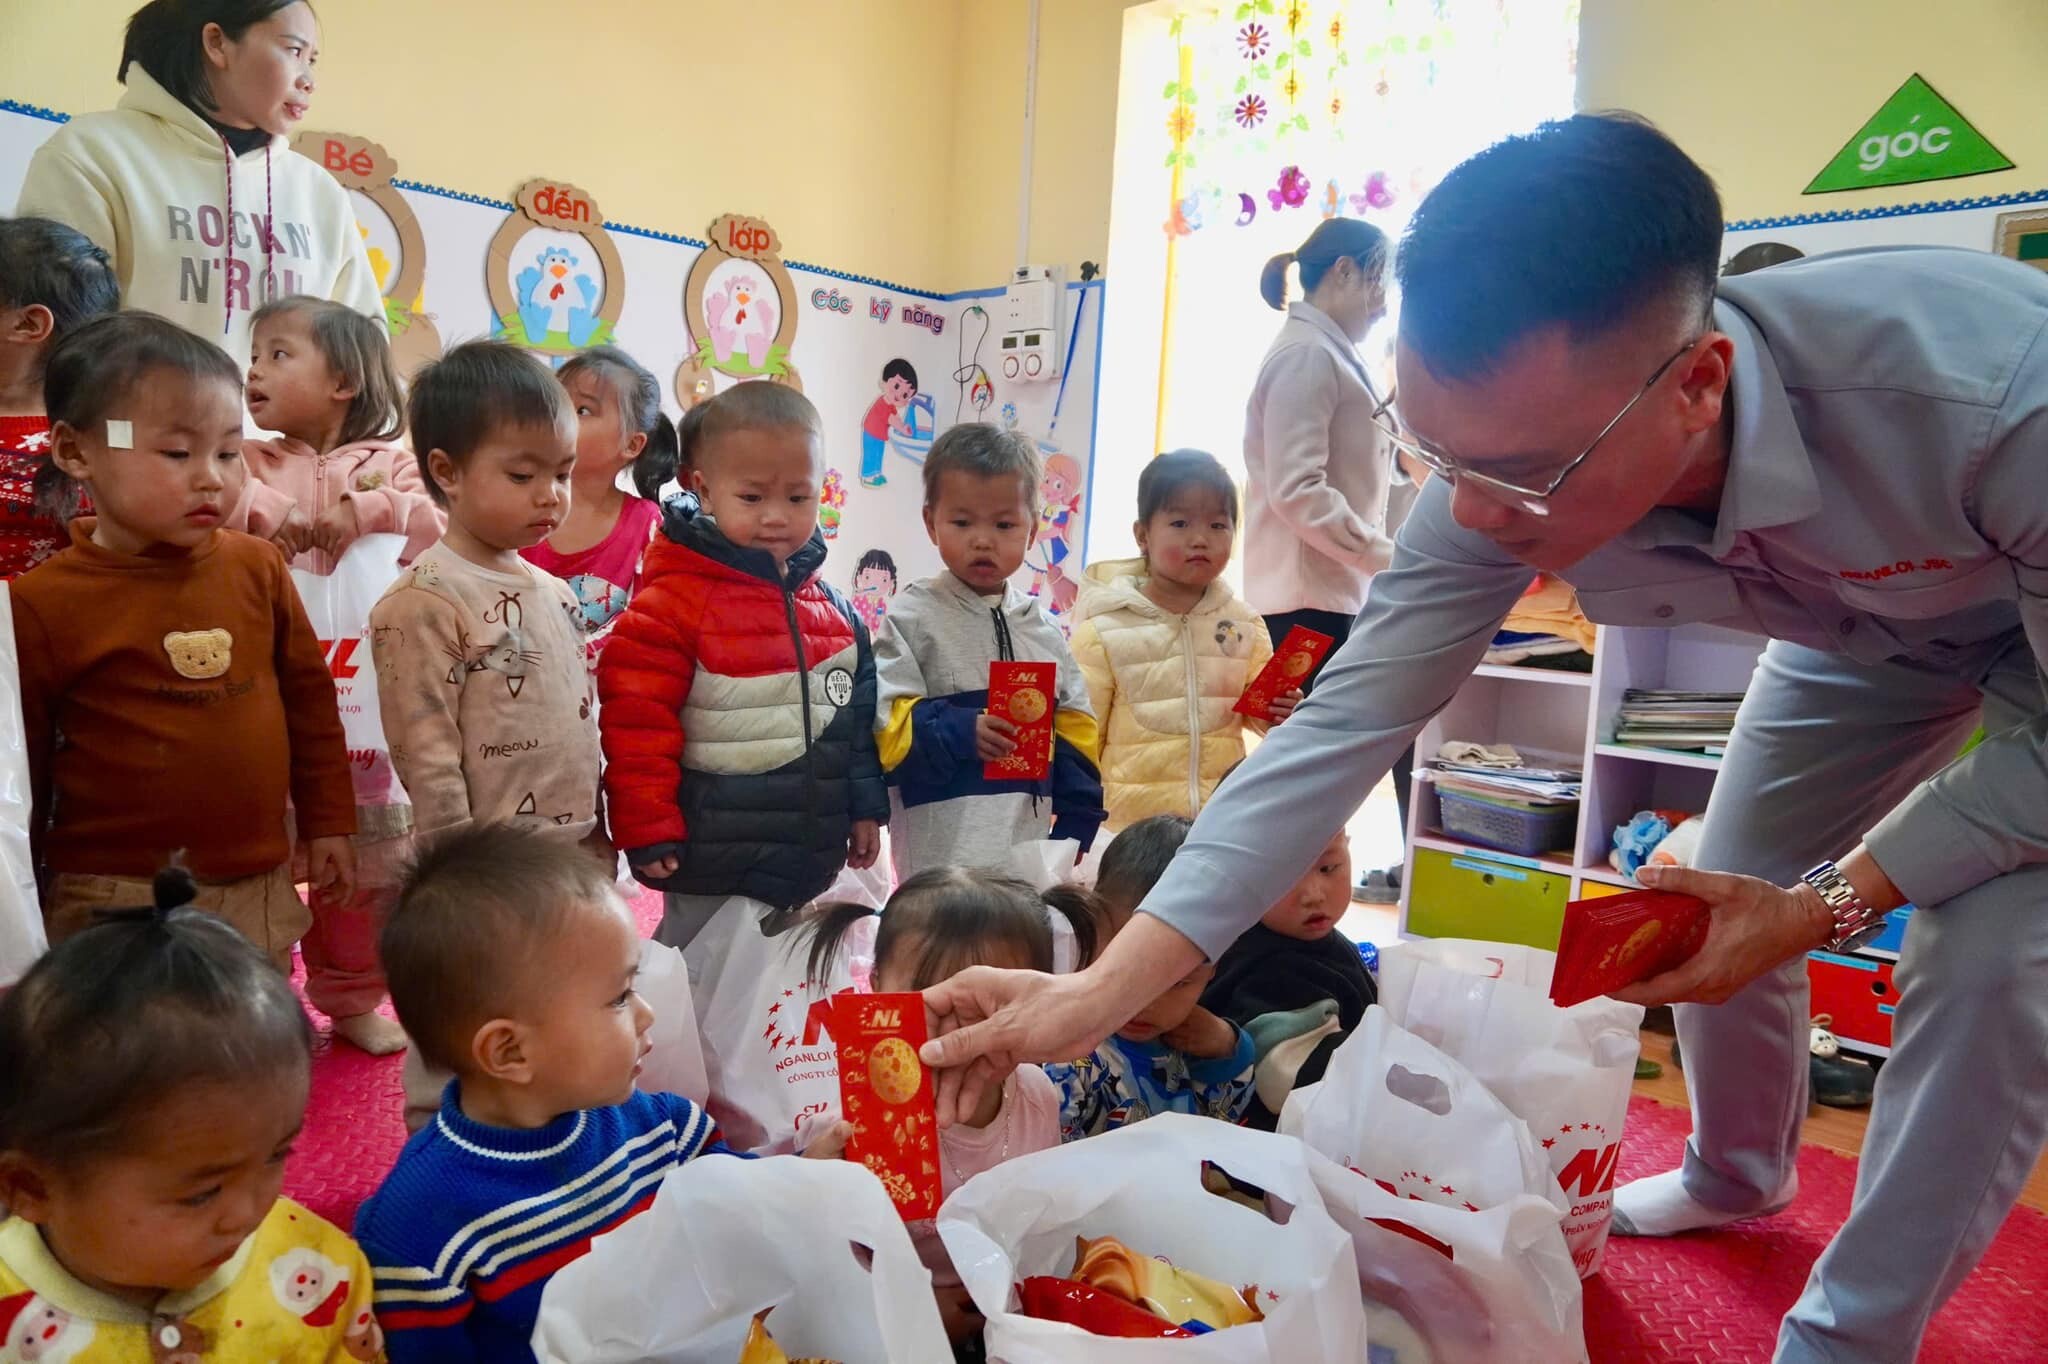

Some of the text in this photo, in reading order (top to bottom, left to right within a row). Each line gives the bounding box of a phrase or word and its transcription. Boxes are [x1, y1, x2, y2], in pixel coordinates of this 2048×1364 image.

[1858, 114, 1952, 171] góc
[324, 140, 374, 177] Bé
[533, 186, 589, 223] đến
[729, 220, 770, 255] lớp
[903, 304, 945, 334] năng
[833, 683, 848, 693] YOU
[1017, 672, 1039, 683] NL
[479, 739, 538, 759] meow
[871, 1009, 902, 1028] NL
[776, 1051, 831, 1072] NGANLOI
[787, 1072, 814, 1084] CÔNG
